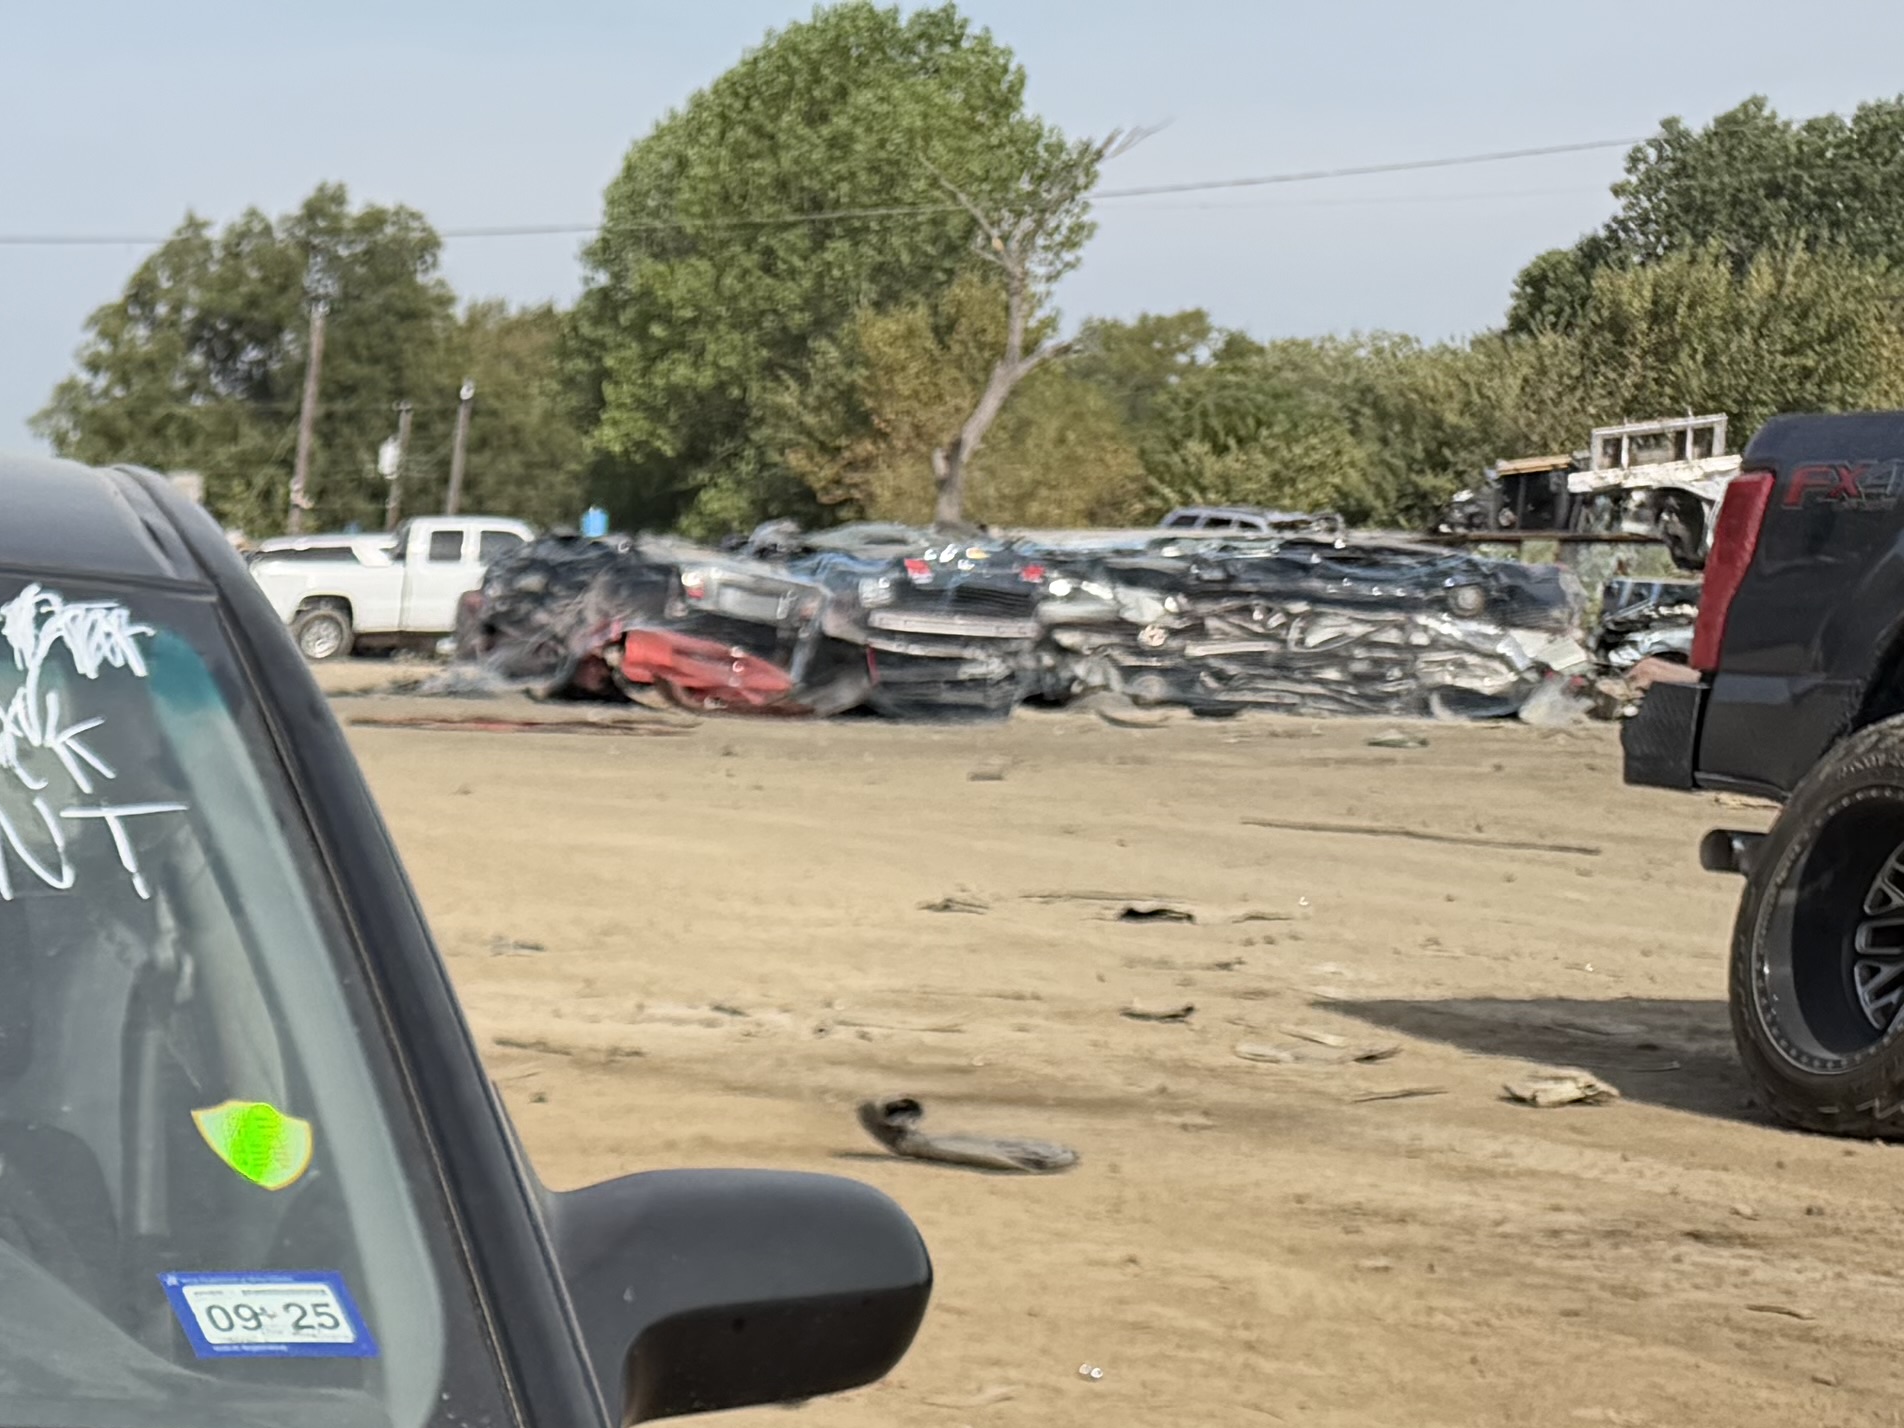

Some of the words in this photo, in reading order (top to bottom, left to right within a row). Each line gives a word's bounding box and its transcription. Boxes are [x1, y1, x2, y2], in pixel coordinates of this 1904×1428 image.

[1781, 459, 1904, 509] FX4
[205, 1303, 264, 1333] 09
[283, 1302, 341, 1332] 25
